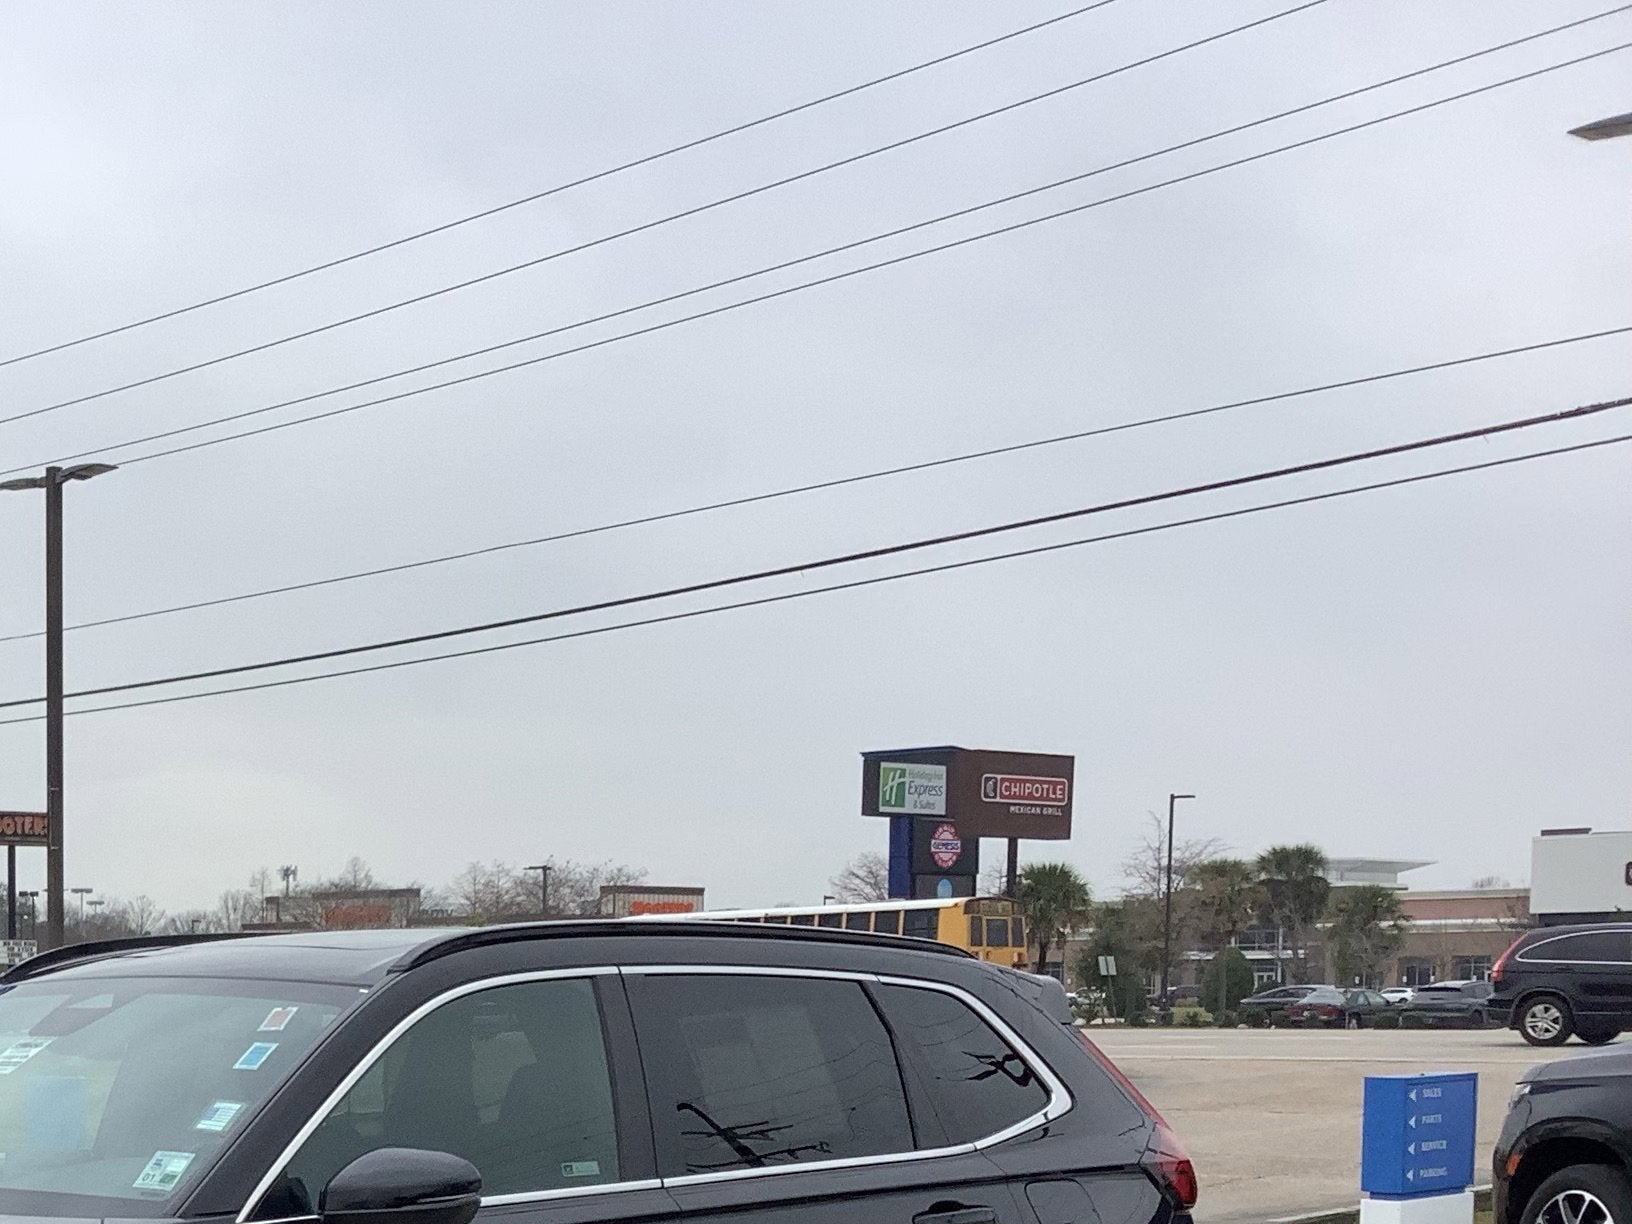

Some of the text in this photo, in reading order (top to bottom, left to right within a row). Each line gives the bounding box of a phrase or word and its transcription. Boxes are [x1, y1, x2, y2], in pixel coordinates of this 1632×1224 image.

[908, 781, 944, 798] Express
[1001, 781, 1064, 799] CHIPOTLE
[1010, 805, 1062, 816] MEXICAN GRILL
